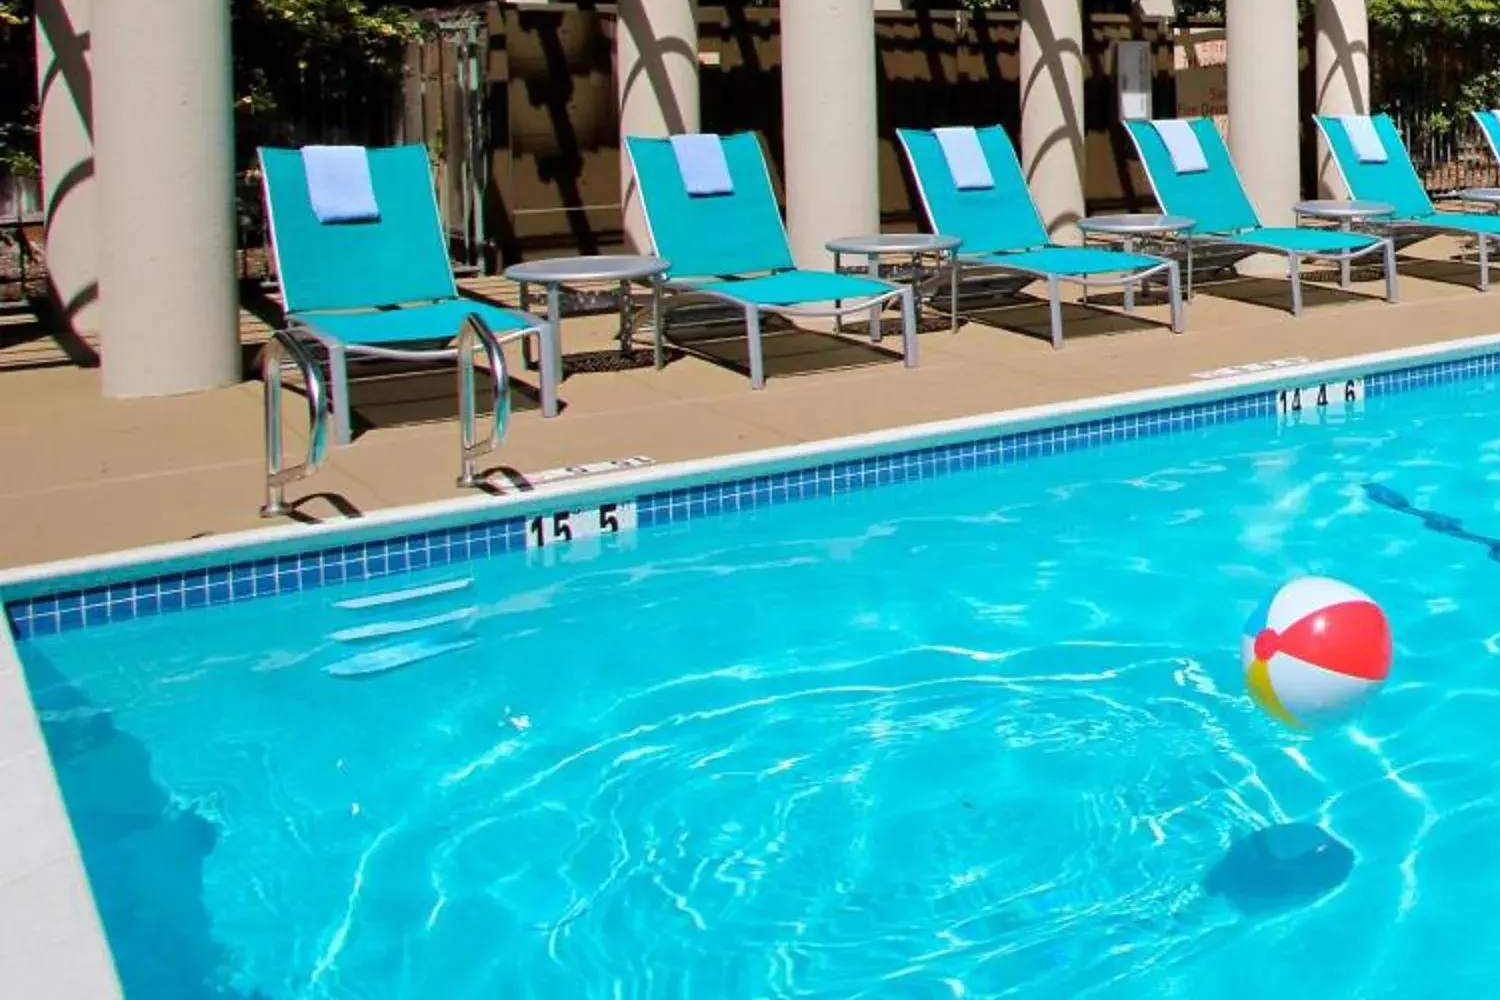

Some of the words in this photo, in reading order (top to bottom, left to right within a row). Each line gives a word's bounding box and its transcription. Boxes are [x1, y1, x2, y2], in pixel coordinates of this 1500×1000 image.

[1317, 383, 1328, 406] 4
[1345, 379, 1356, 402] 6
[600, 503, 618, 533] 5
